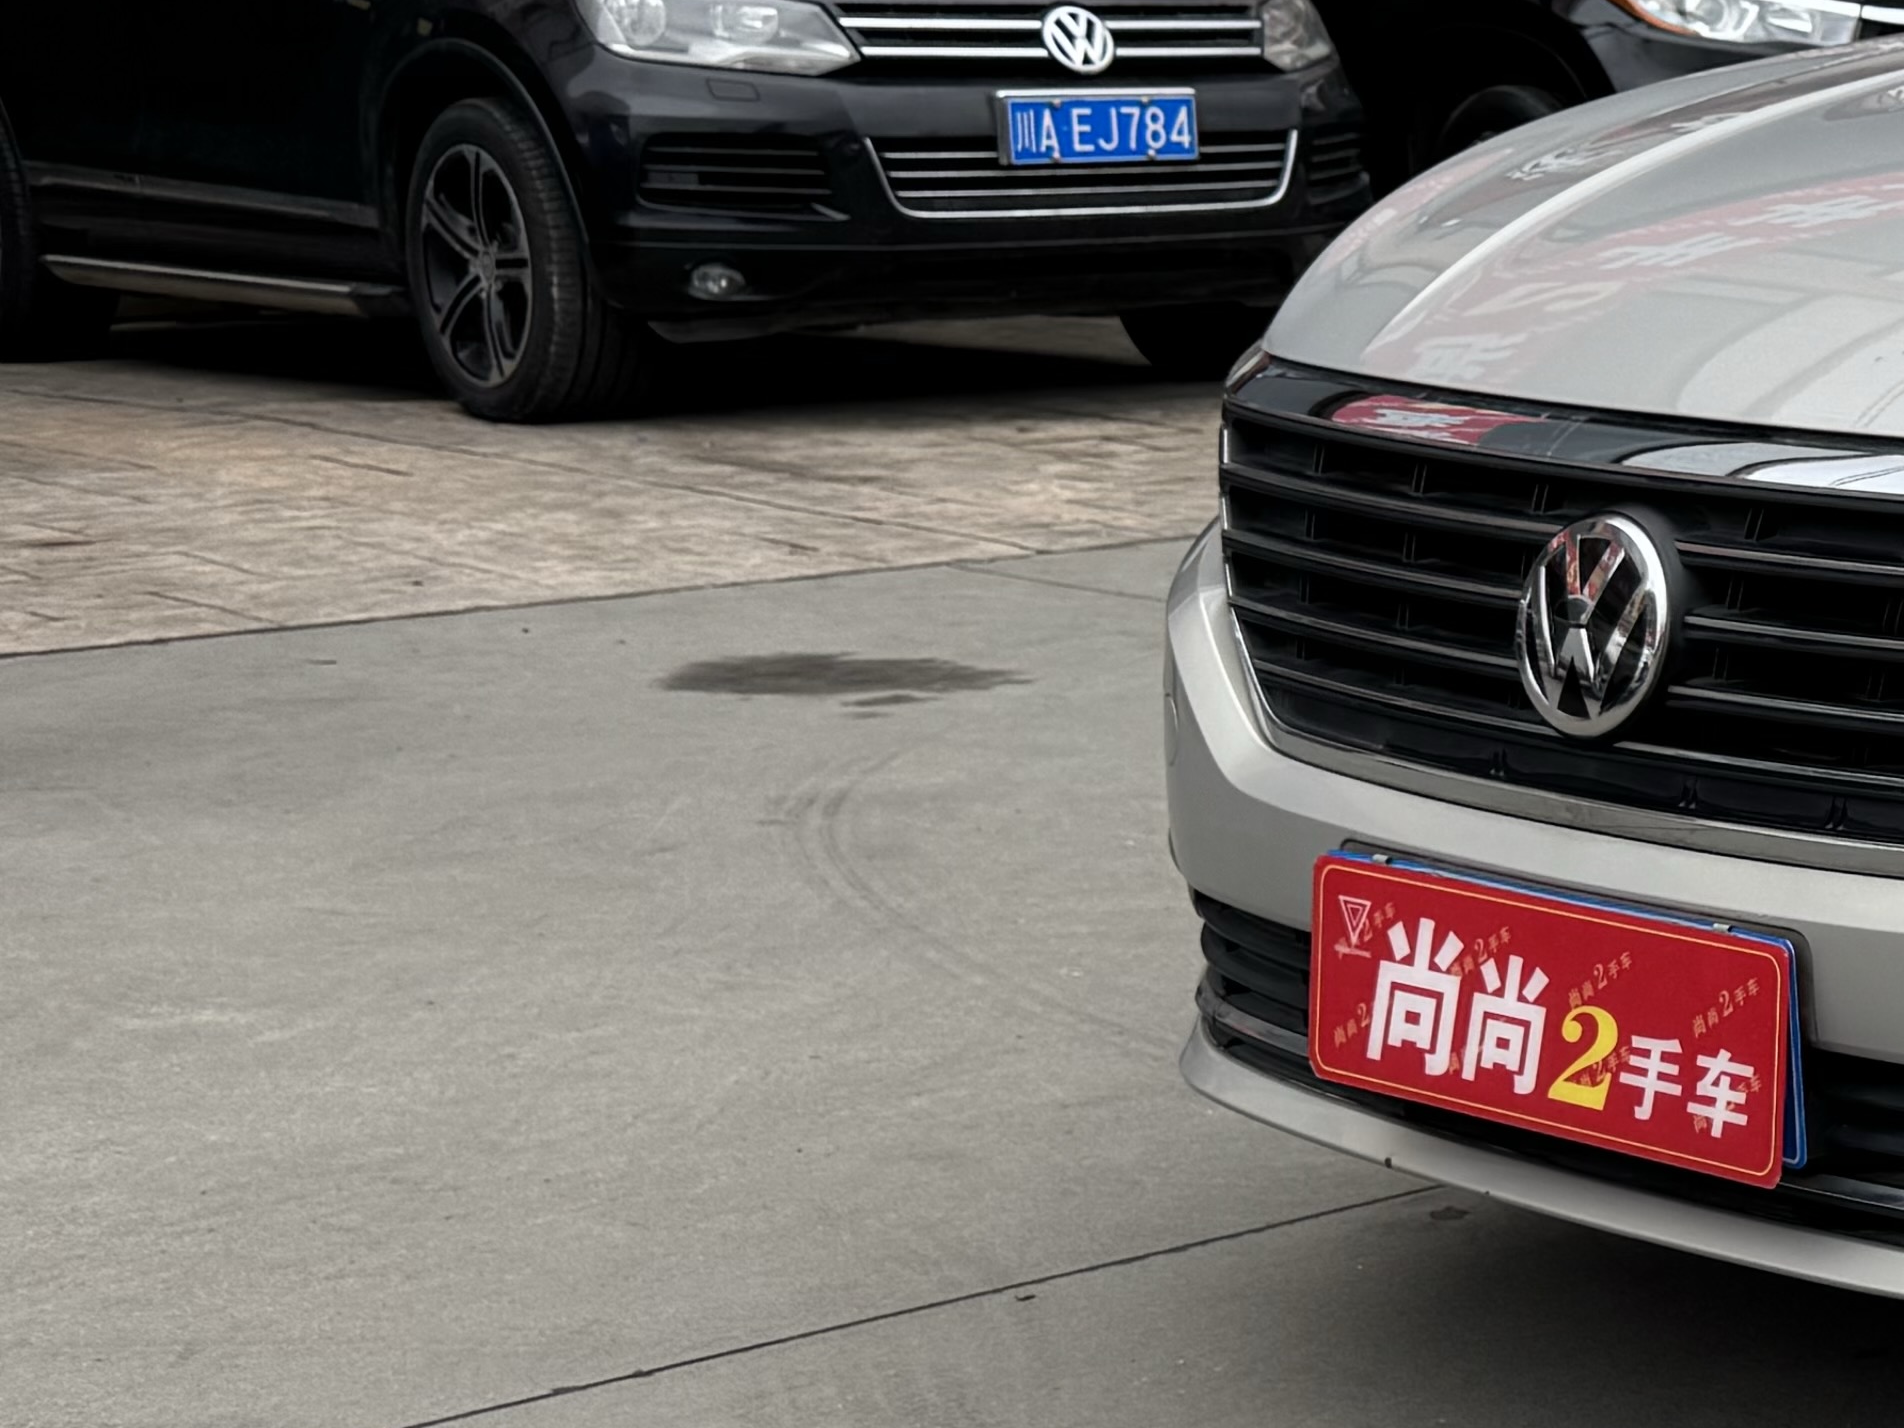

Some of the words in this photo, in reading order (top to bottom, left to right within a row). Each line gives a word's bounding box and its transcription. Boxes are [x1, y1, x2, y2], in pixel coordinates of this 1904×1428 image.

[1366, 917, 1756, 1139] 尚尚2手车
[1692, 977, 1761, 1039] 尚尚2手车
